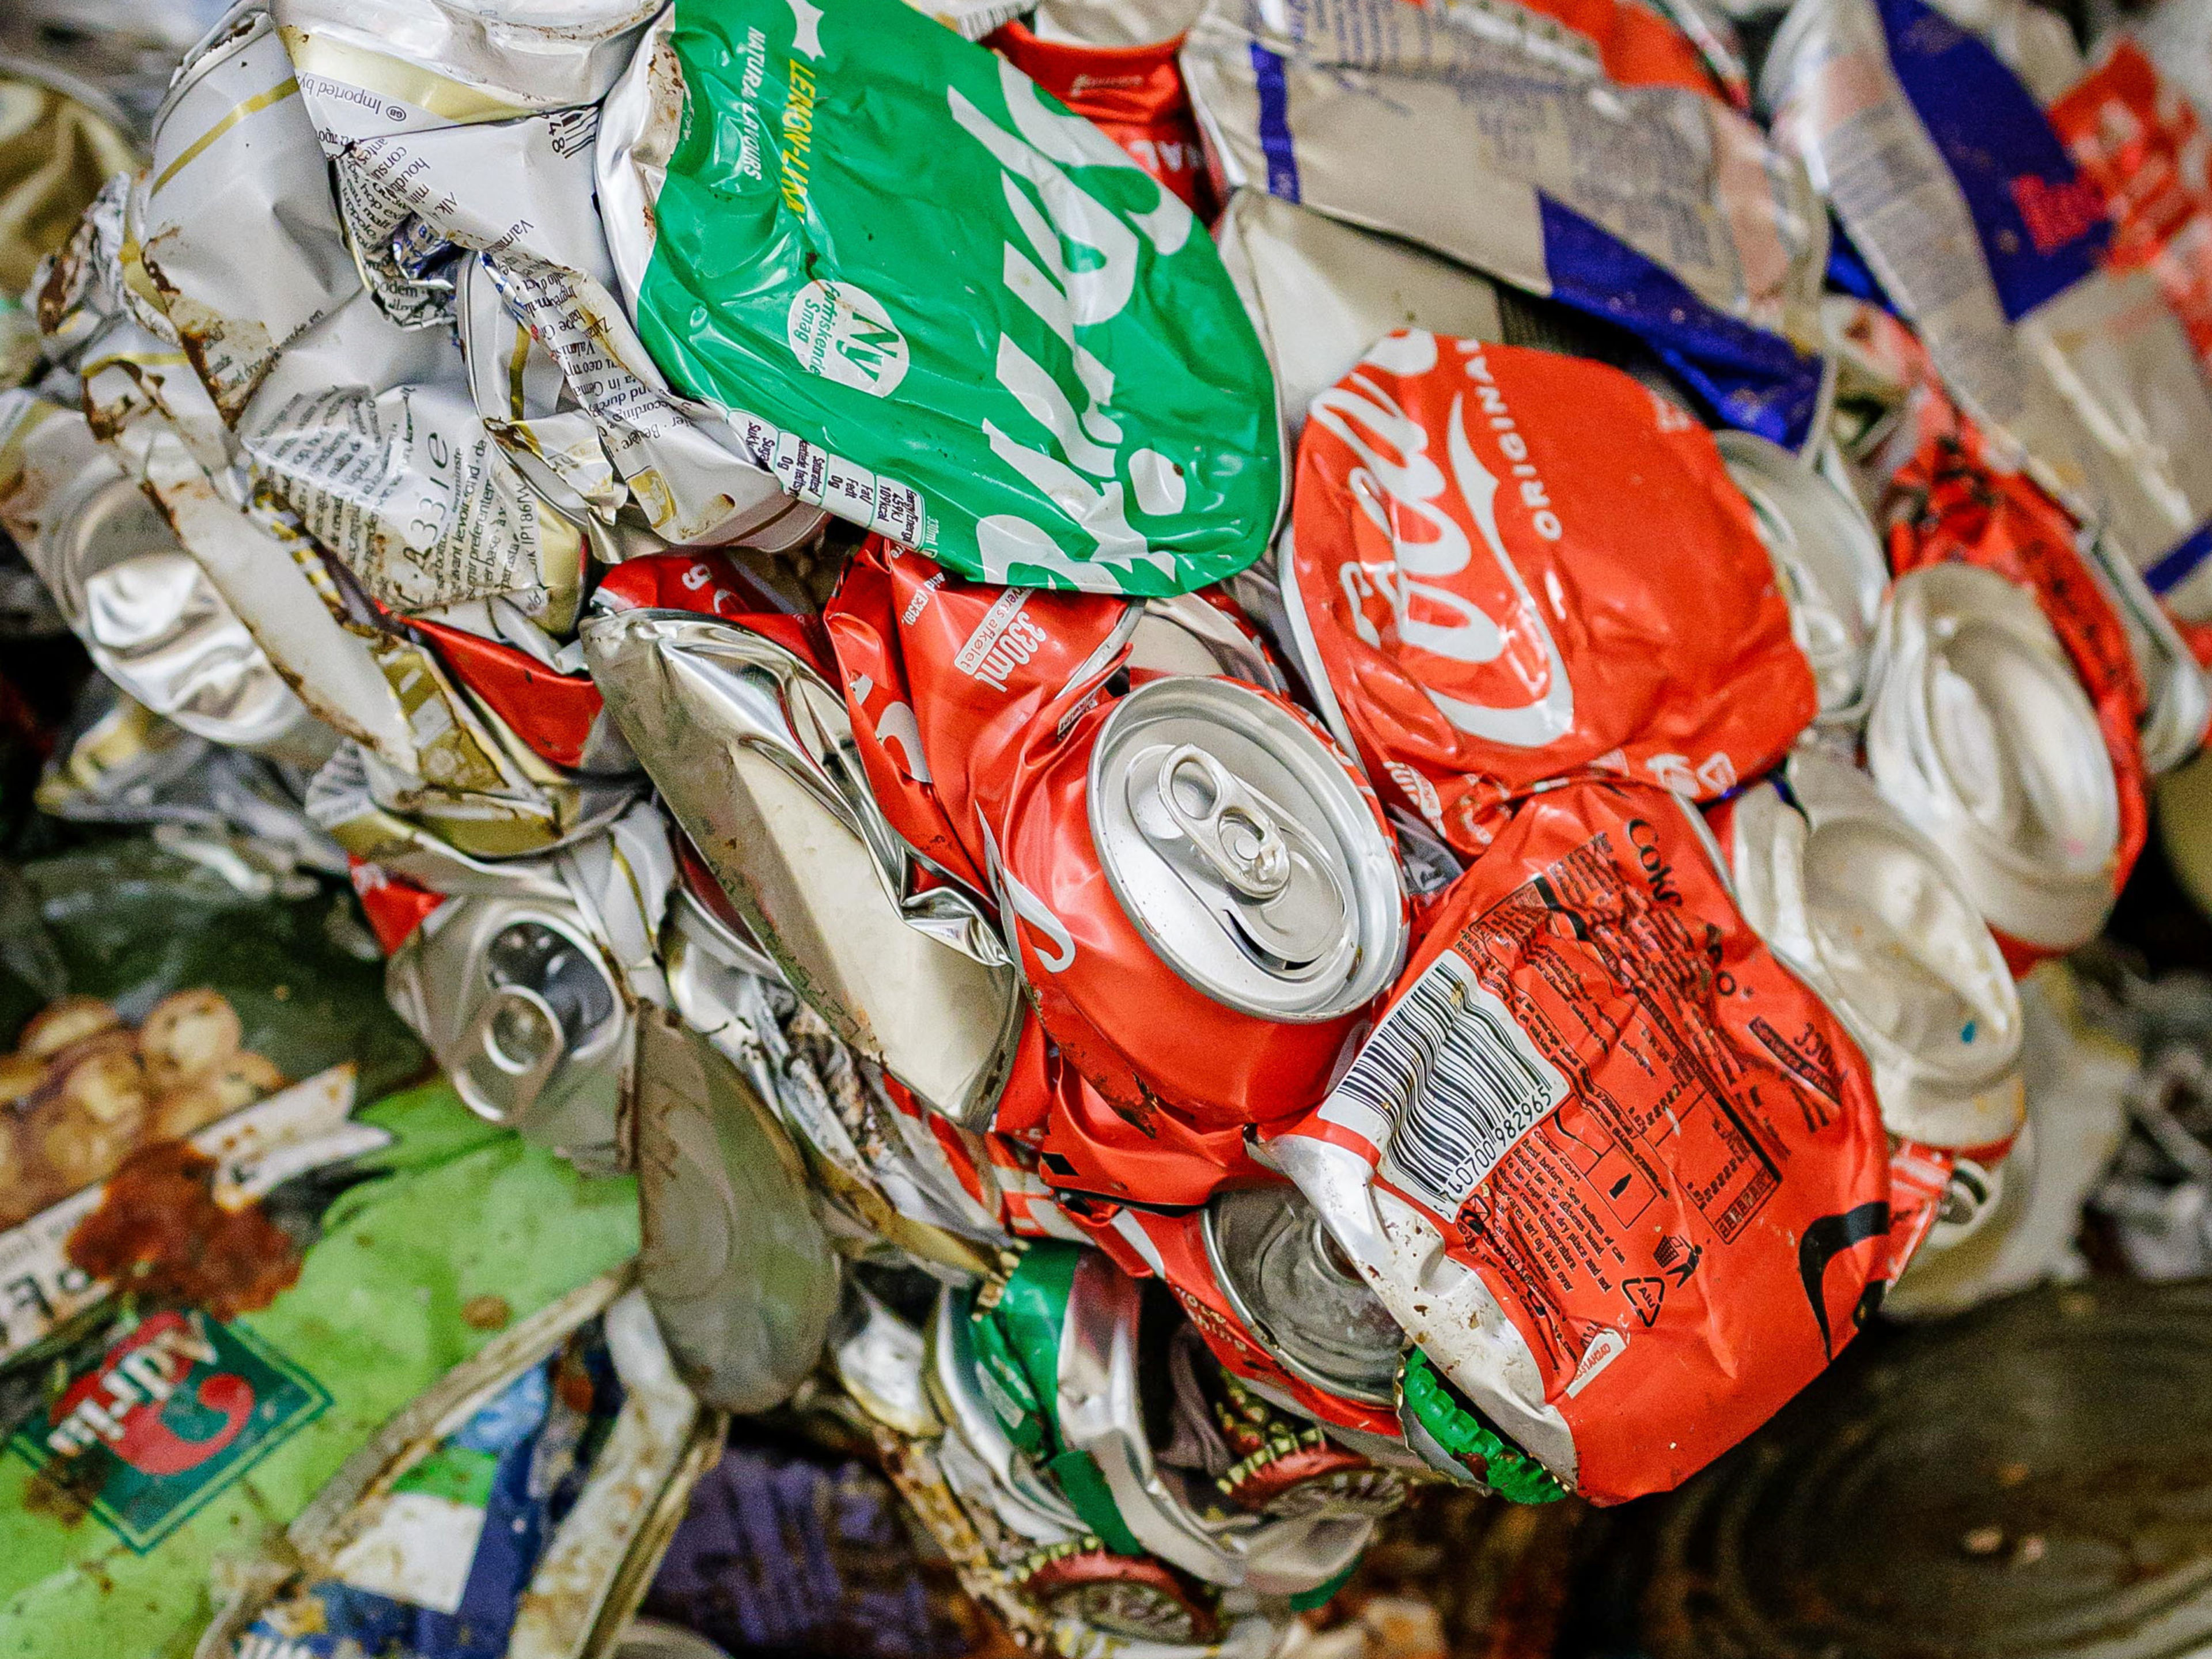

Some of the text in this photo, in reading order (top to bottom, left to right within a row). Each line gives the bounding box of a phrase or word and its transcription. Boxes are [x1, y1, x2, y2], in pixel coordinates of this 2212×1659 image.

[317, 84, 381, 114] Imported
[738, 26, 765, 181] NATURA LAVOURS
[778, 58, 817, 219] LEMON-LIM
[796, 298, 821, 355] Smag
[836, 311, 900, 384] Ny
[844, 477, 859, 499] Fedt
[959, 619, 999, 671] afkølet
[974, 610, 1047, 692] 330ml
[1494, 1085, 1552, 1147] 982965
[1512, 1146, 1536, 1174] Bedst
[1546, 1187, 1561, 1202] Se
[1517, 1191, 1540, 1216] room
[1521, 1137, 1542, 1160] Best
[1564, 1186, 1583, 1206] See
[1603, 1234, 1615, 1247] of
[1503, 1156, 1517, 1170] To
[1512, 1168, 1526, 1182] be
[1553, 1215, 1572, 1234] dry
[1565, 1232, 1591, 1260] place
[1583, 1256, 1603, 1277] and
[1596, 1275, 1613, 1293] not
[1531, 1237, 1547, 1253] og
[1541, 1248, 1563, 1272] ikke
[1554, 1271, 1575, 1294] over
